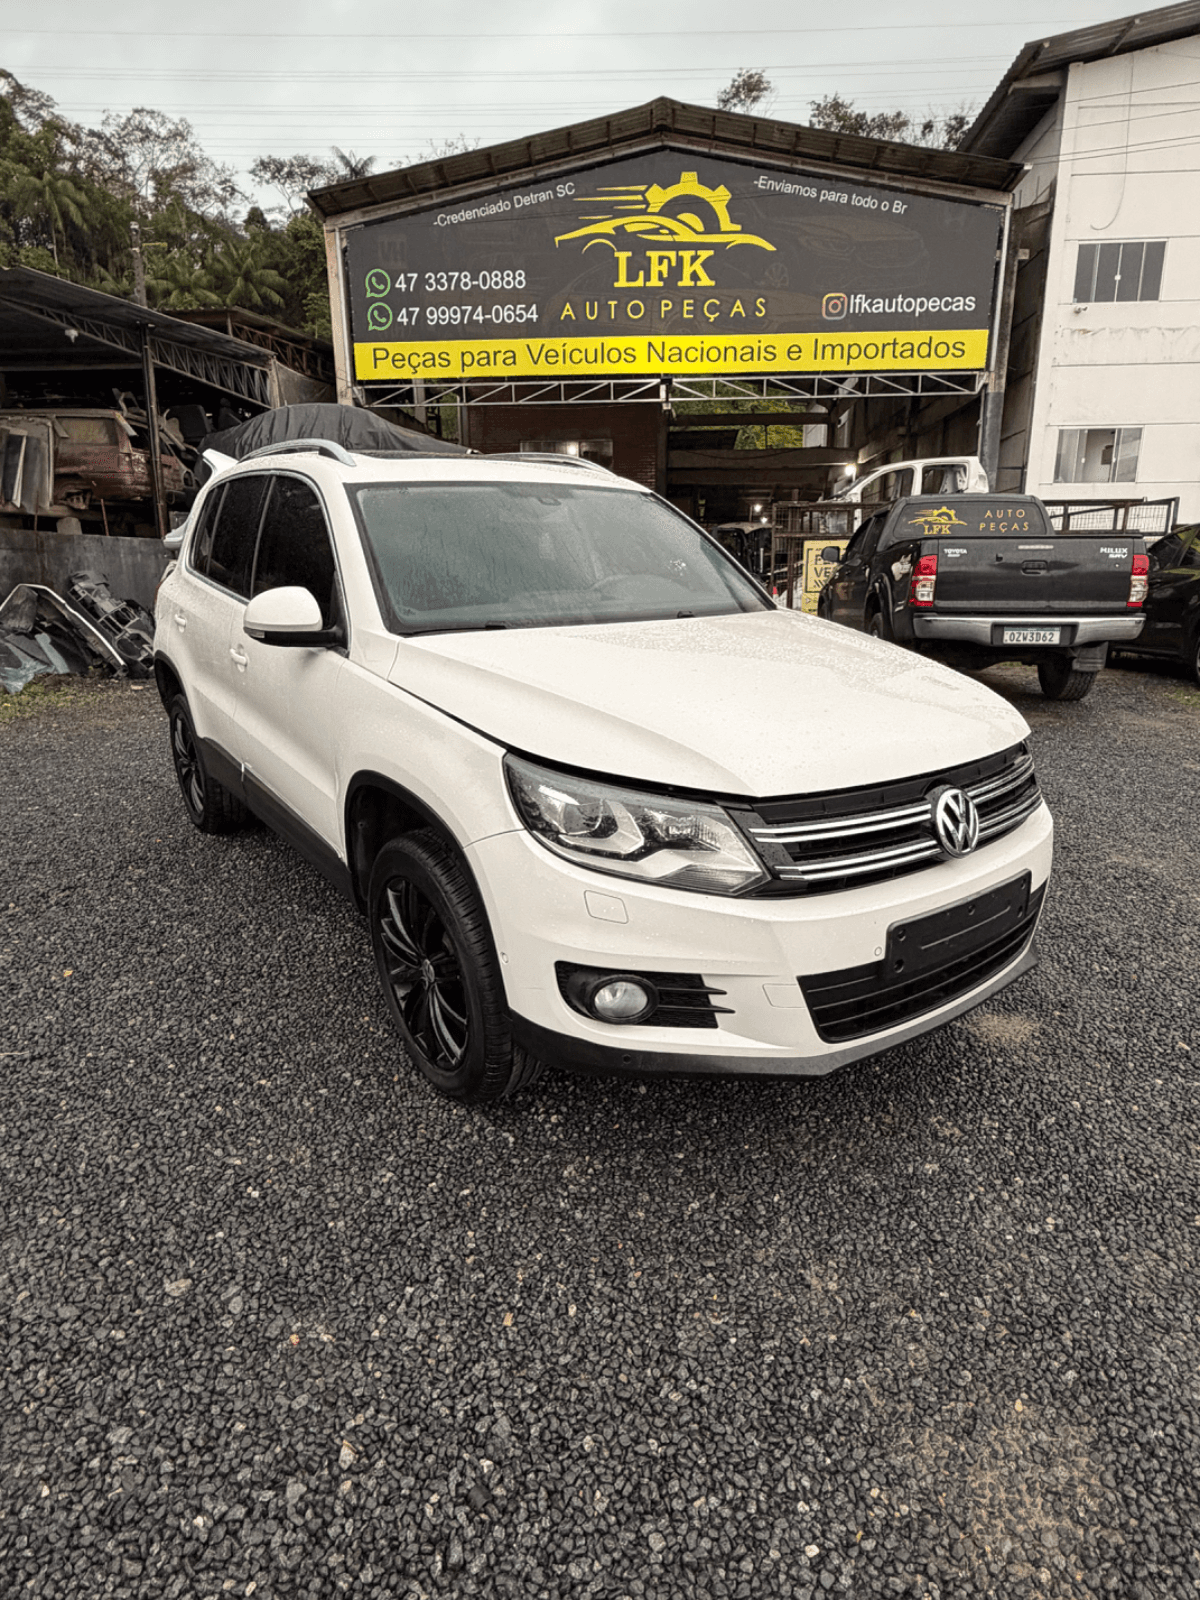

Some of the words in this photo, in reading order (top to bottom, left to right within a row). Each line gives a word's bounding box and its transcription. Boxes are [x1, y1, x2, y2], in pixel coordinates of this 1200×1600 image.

[433, 199, 511, 227] -Credenciado
[513, 189, 554, 209] Detran
[556, 182, 576, 198] SC
[753, 175, 818, 198] -Enviamos
[819, 190, 849, 204] para
[851, 193, 879, 209] todo
[881, 201, 890, 212] o
[892, 200, 908, 215] Br
[613, 250, 716, 288] LFK
[395, 273, 418, 293] 47
[425, 270, 526, 292] 3378-0888
[397, 307, 420, 326] 47
[426, 304, 539, 325] 99974-0654
[560, 300, 645, 321] AUTO
[660, 298, 766, 322] PEÇAS
[850, 293, 976, 316] lfkautopecas
[372, 347, 451, 374] Peças
[460, 349, 517, 372] para
[526, 342, 637, 366] Veículos
[647, 339, 778, 365] Nacionais
[787, 342, 802, 361] e
[813, 336, 966, 365] Importados
[984, 509, 1026, 518] AUTO
[924, 525, 951, 535] LFK
[979, 522, 1029, 533] PEÇAS
